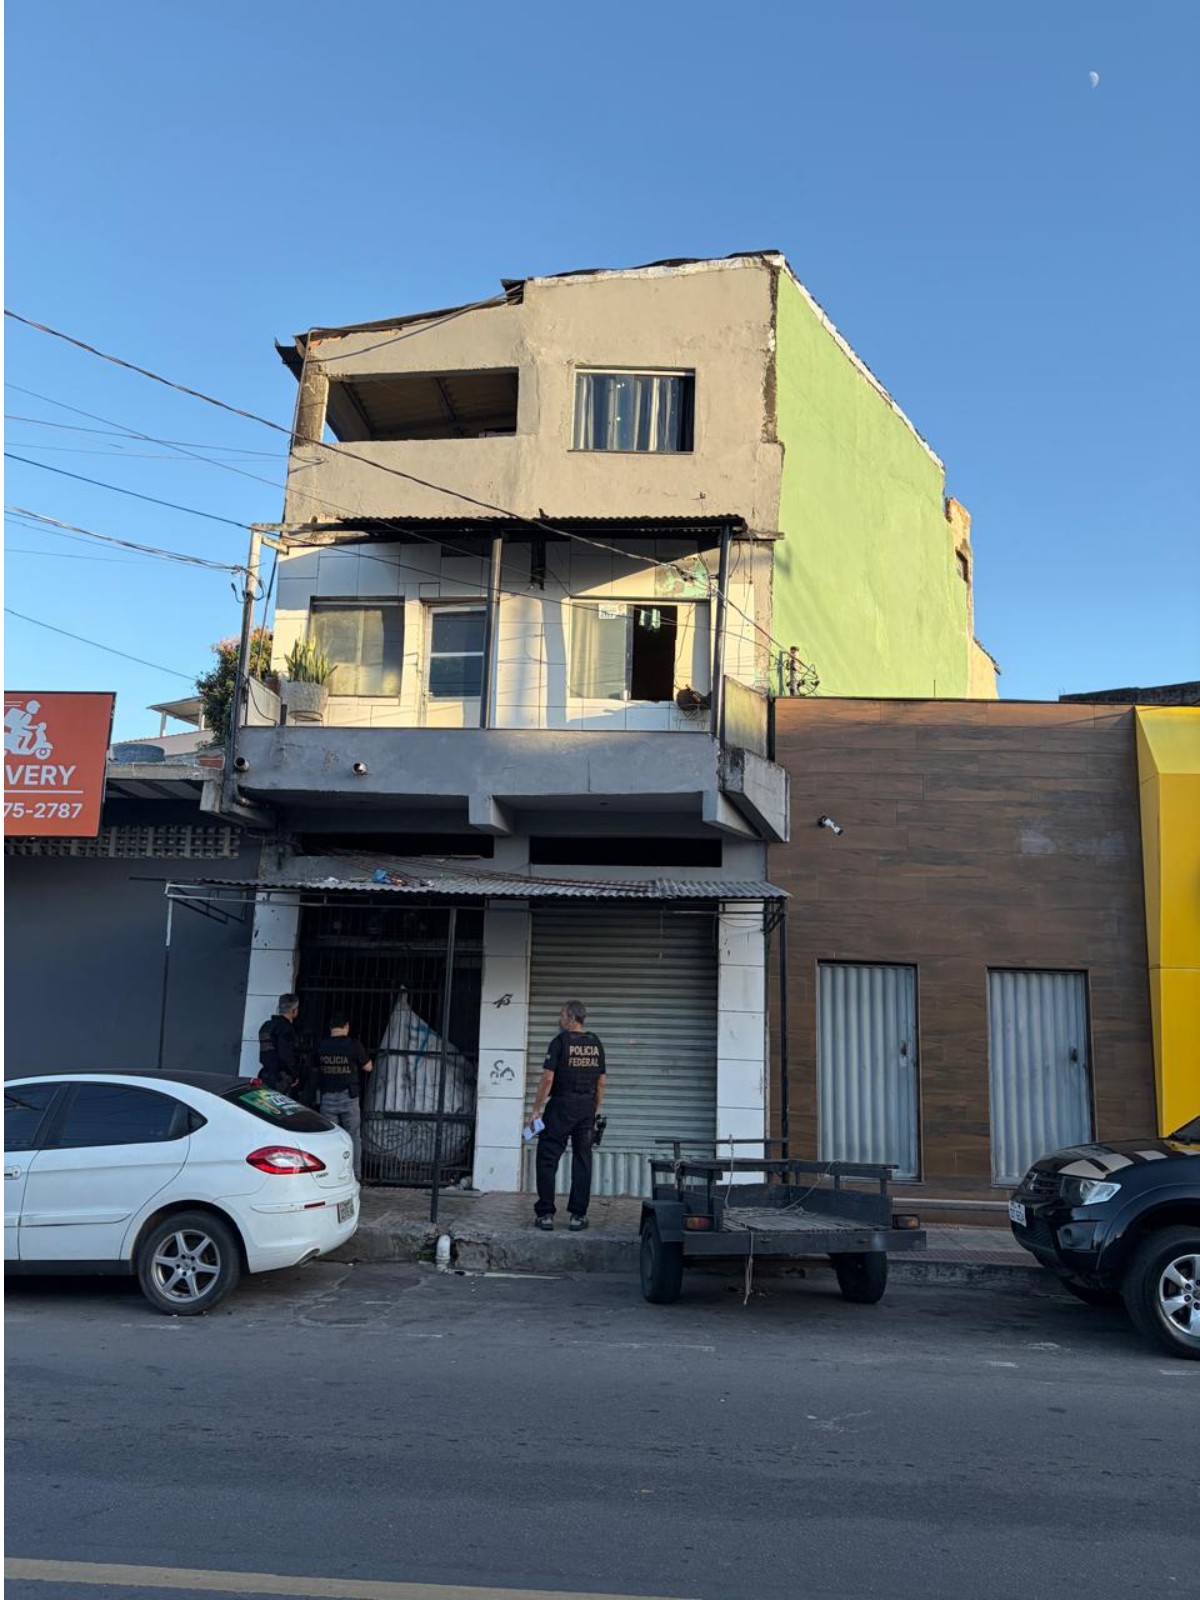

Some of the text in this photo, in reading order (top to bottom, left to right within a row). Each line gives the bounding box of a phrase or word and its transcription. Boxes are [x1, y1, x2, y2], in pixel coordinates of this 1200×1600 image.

[5, 764, 76, 786] VERY
[4, 803, 83, 818] 75-2787
[568, 1057, 600, 1067] FEDERAL
